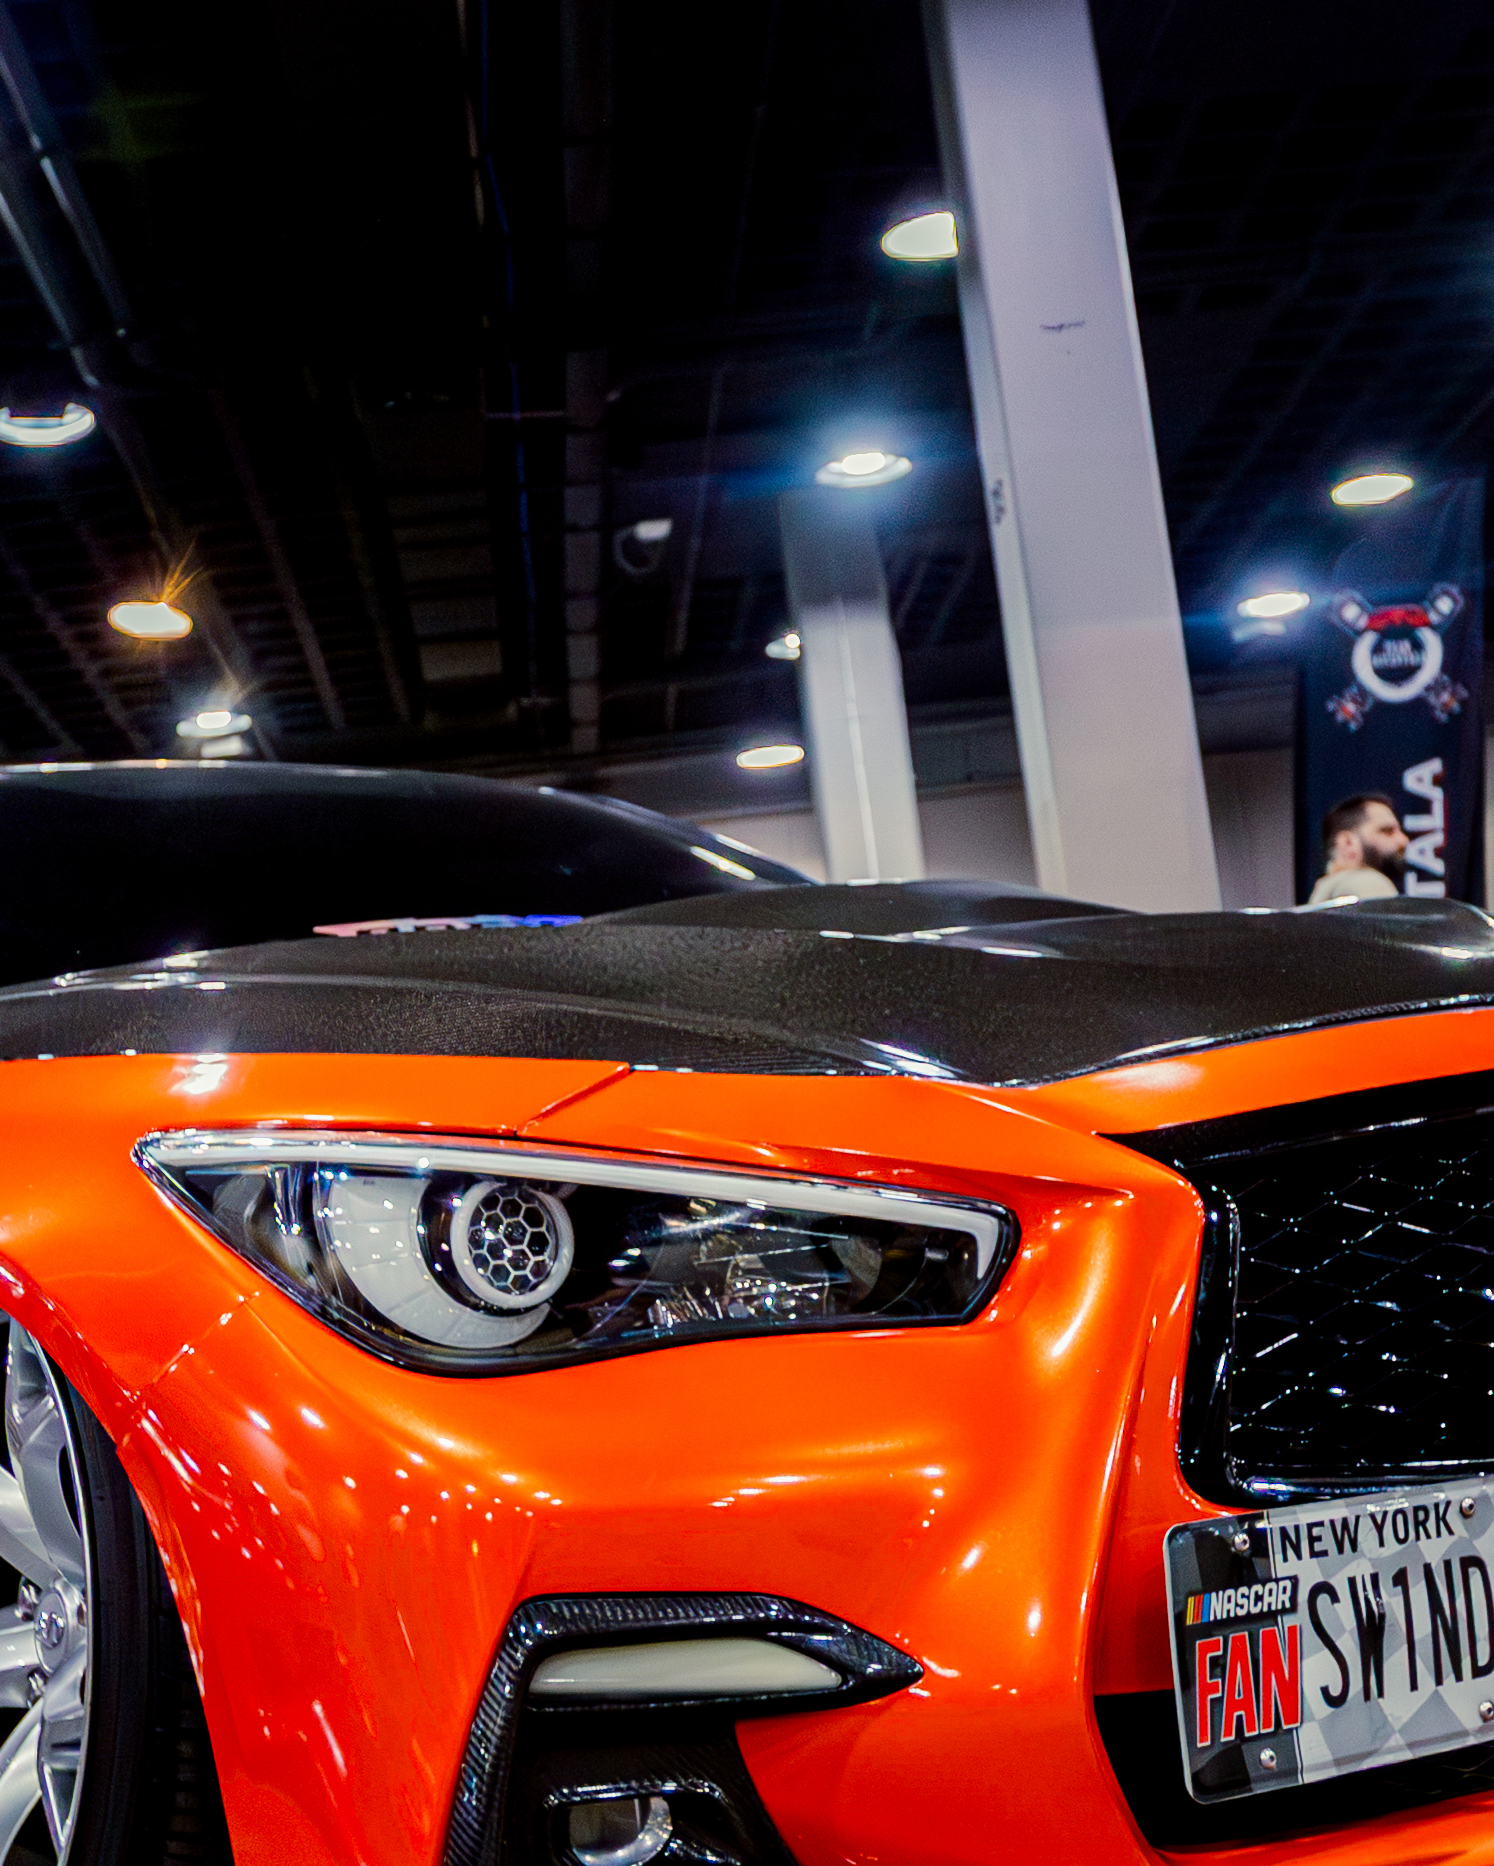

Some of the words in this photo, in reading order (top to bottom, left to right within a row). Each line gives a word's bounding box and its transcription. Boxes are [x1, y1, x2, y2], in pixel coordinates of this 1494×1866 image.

[1278, 1514, 1362, 1564] NEW
[1368, 1499, 1456, 1549] YORK
[1209, 1578, 1294, 1622] NASCAR
[1195, 1623, 1302, 1749] FAN
